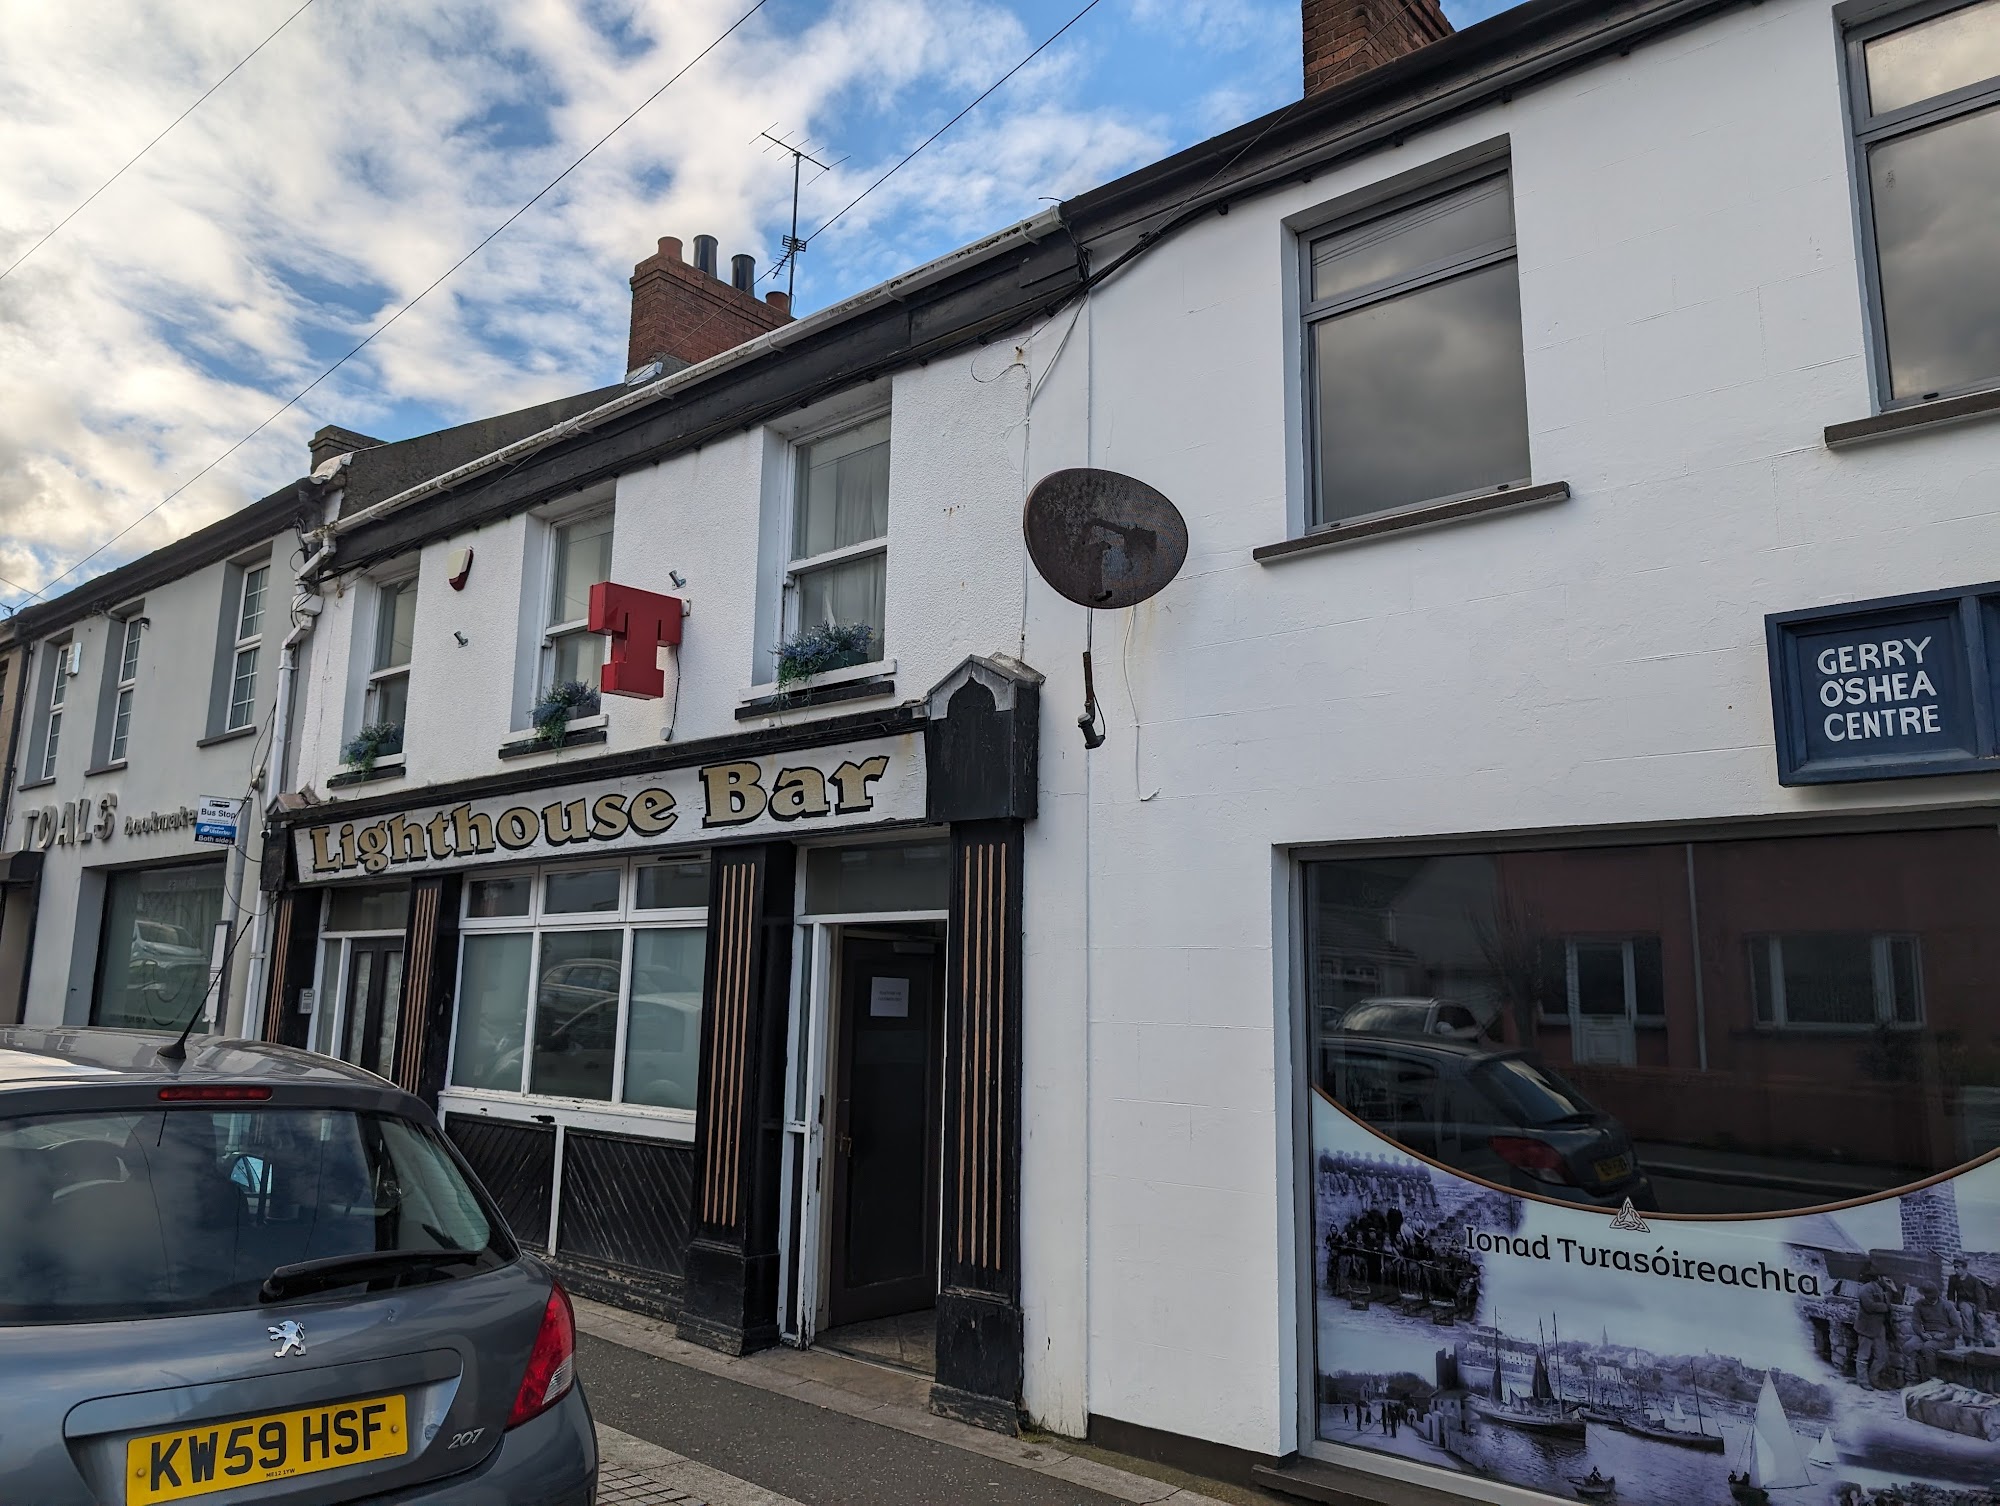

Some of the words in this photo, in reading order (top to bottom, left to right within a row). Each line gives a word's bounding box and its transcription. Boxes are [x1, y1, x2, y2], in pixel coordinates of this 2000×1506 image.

[1817, 636, 1932, 675] GERRY
[1820, 670, 1938, 707] O'SHEA
[1824, 704, 1941, 742] CENTRE
[20, 793, 118, 850] TOALS
[124, 805, 198, 836] bookmake
[201, 808, 216, 817] Bus
[218, 810, 236, 819] Stop
[309, 787, 677, 874] Lighthouse
[700, 755, 890, 827] Bar
[1465, 1226, 1551, 1260] Ionad
[1557, 1237, 1822, 1297] Turasóireachta
[150, 1421, 287, 1491] KW59
[303, 1404, 387, 1462] HSF
[447, 1427, 485, 1450] 207
